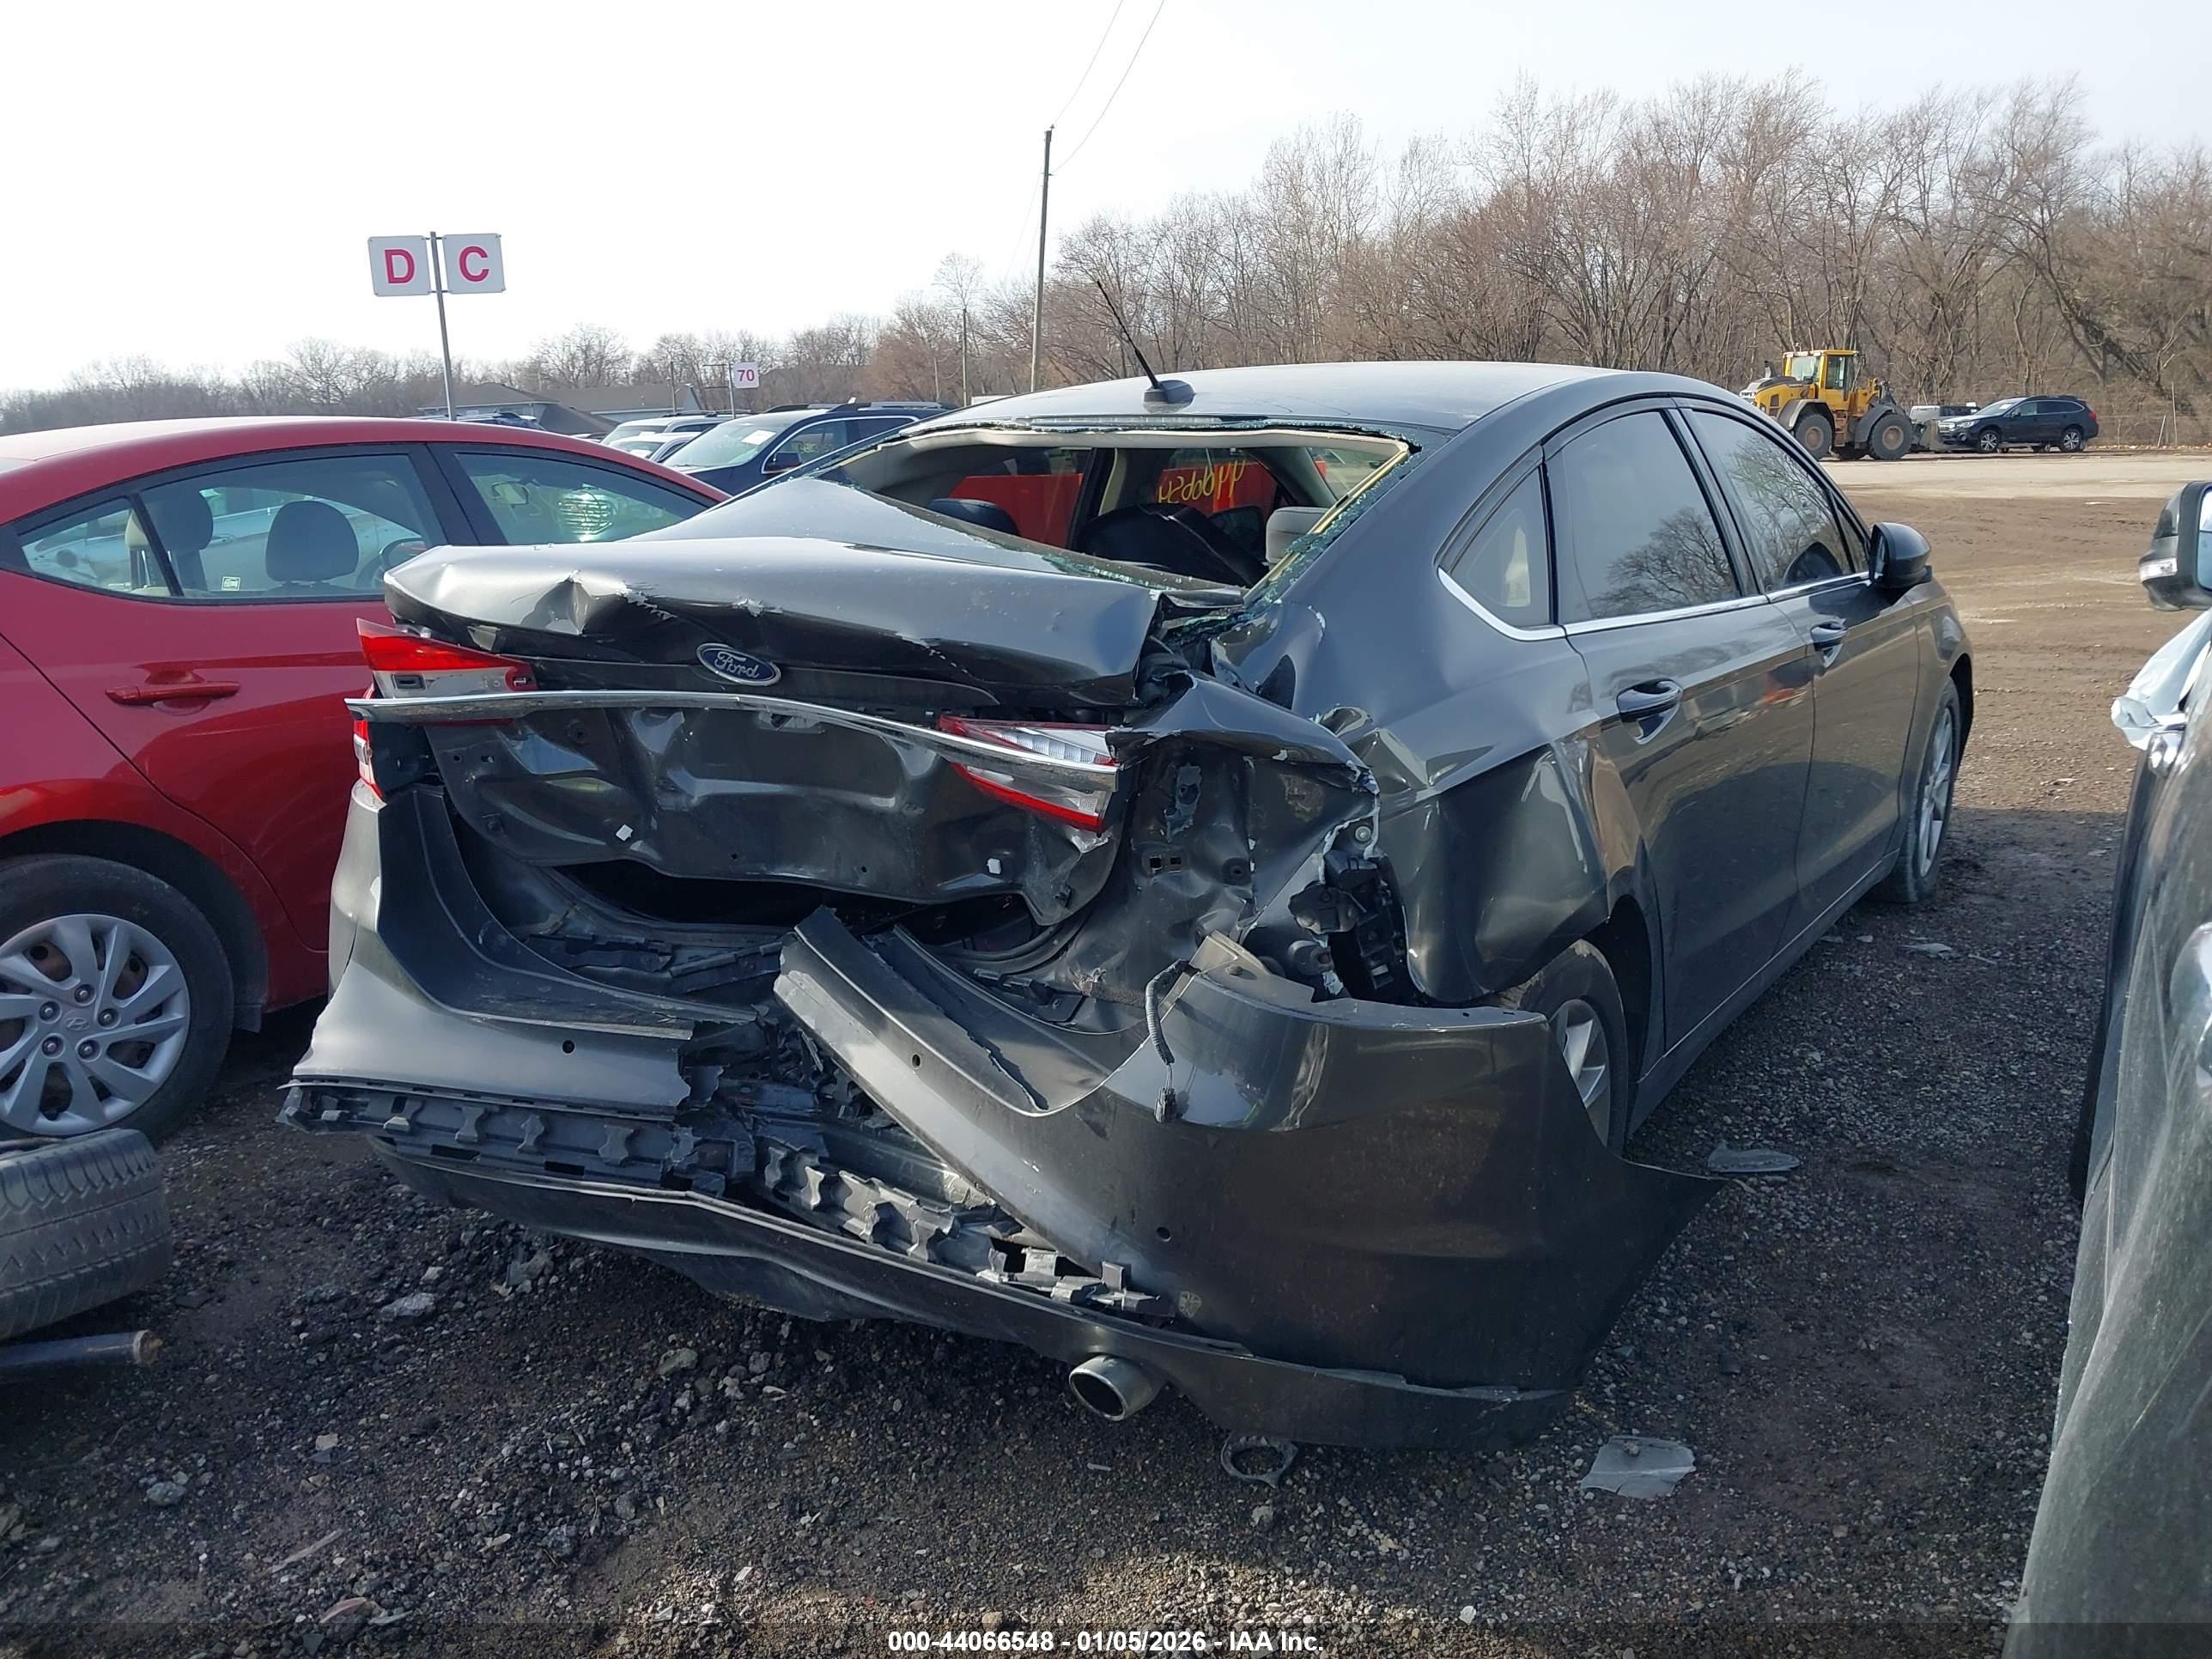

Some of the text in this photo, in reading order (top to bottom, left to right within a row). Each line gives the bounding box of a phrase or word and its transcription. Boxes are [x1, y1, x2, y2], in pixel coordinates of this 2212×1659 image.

[385, 249, 415, 283] D
[459, 246, 489, 282] C
[737, 369, 755, 381] 70
[715, 651, 760, 678] Ford
